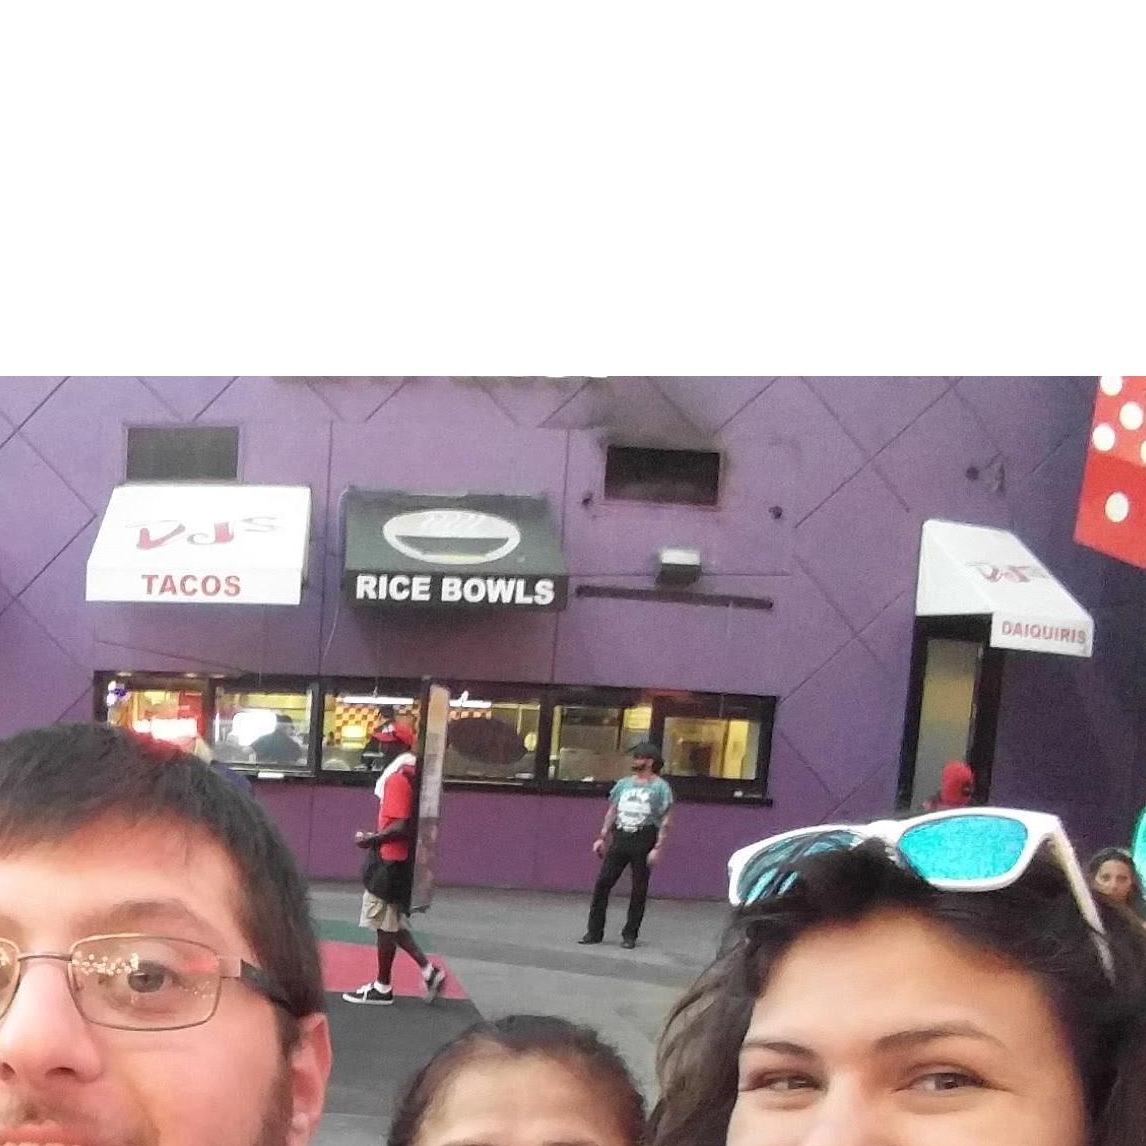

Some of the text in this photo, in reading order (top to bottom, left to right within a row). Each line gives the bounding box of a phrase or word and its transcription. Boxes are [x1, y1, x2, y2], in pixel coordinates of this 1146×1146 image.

[142, 574, 241, 597] TACOS
[356, 574, 555, 605] RICE BOWLS
[1000, 620, 1087, 644] DAIQUIRIS
